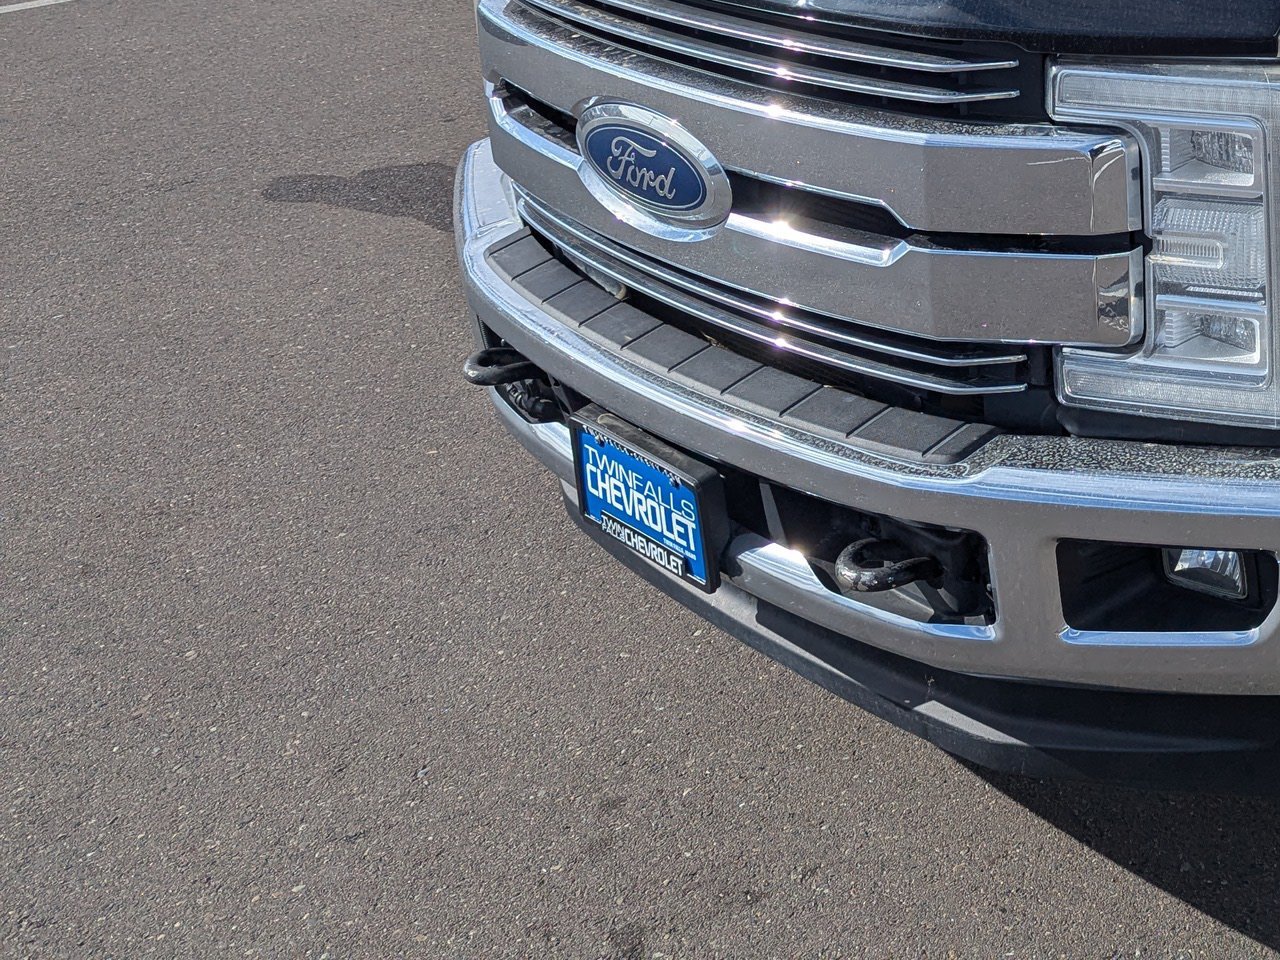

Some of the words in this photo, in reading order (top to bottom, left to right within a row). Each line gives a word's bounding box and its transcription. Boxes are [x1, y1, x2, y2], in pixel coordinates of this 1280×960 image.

[606, 136, 676, 200] Ford
[585, 463, 697, 552] CHEVROLET
[624, 528, 683, 576] CHEVROLET
